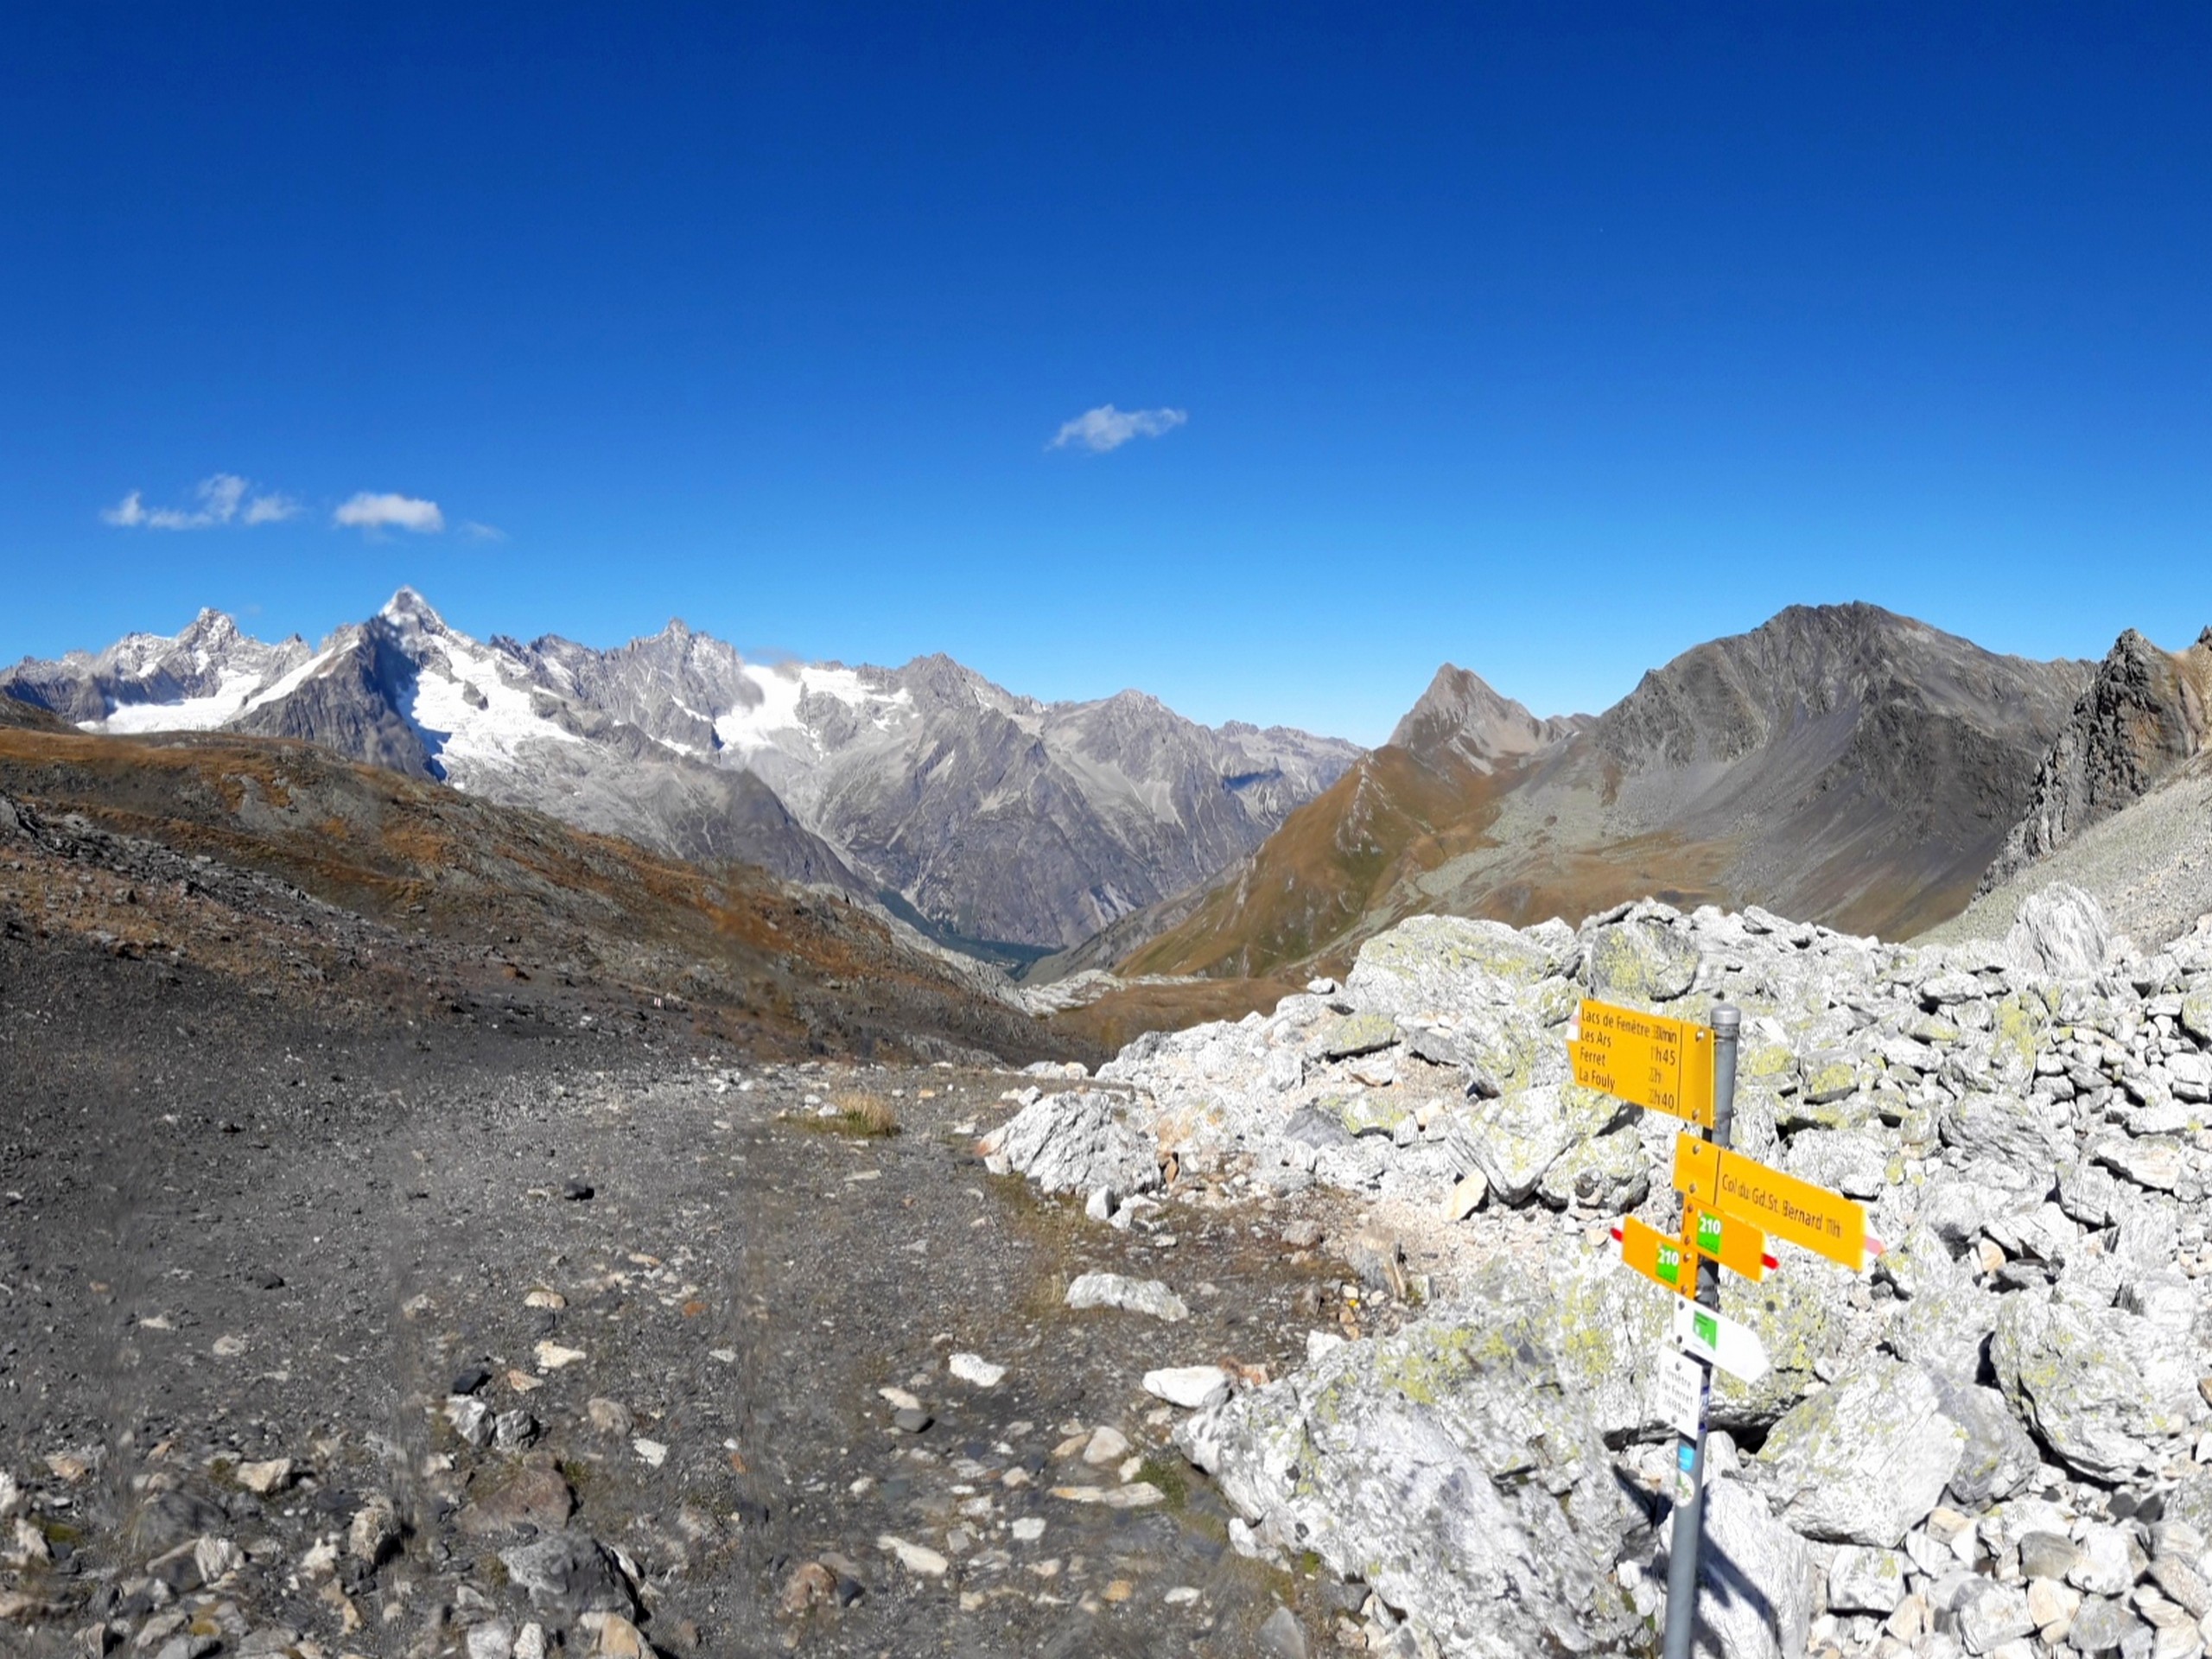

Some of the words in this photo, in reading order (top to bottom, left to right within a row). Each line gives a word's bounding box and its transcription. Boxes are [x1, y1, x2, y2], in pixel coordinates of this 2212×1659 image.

[1581, 1007, 1600, 1025] Lacs
[1603, 1012, 1614, 1027] de
[1617, 1016, 1650, 1039] Fenêtre
[1580, 1027, 1595, 1043] Les
[1596, 1031, 1611, 1048] Ars
[1580, 1046, 1605, 1067] Ferret
[1579, 1066, 1589, 1082] La
[1591, 1070, 1616, 1093] Fouly
[1722, 1173, 1738, 1194] Col
[1738, 1182, 1749, 1200] du
[1782, 1199, 1823, 1231] Bernard
[1698, 1217, 1721, 1235] 210
[1657, 1248, 1680, 1267] 210
